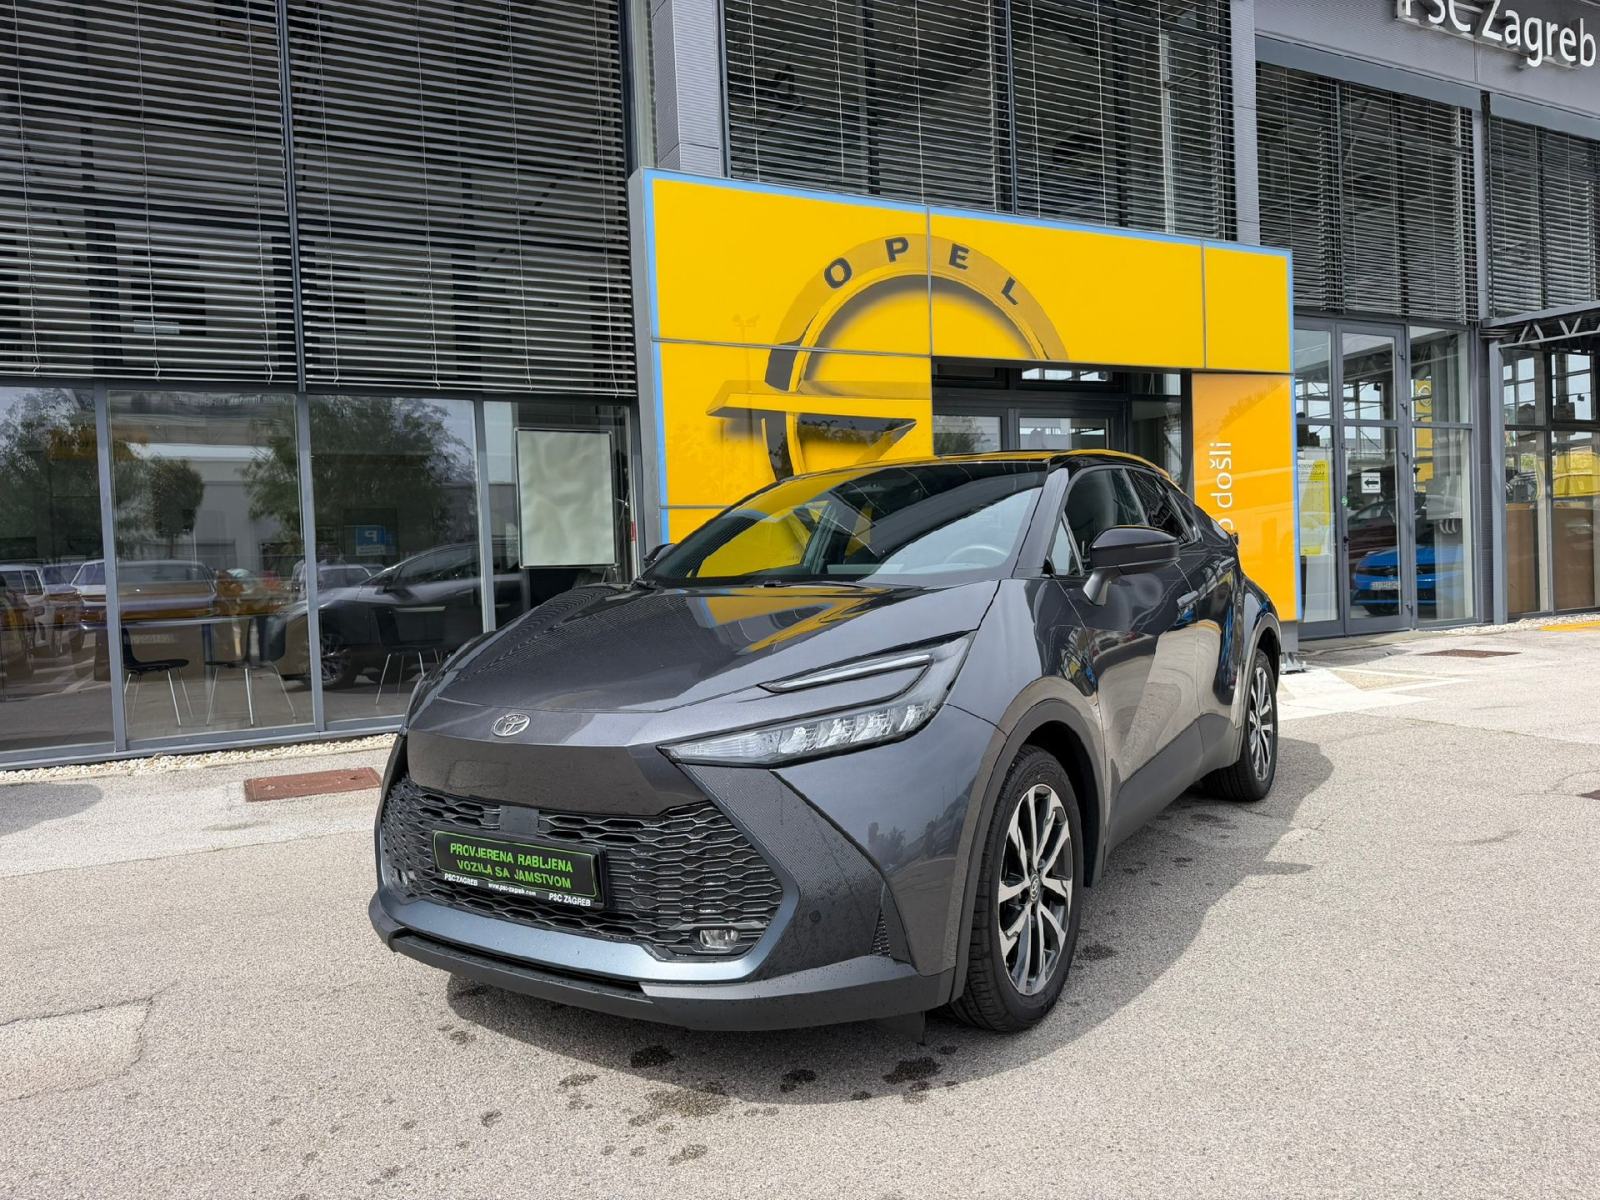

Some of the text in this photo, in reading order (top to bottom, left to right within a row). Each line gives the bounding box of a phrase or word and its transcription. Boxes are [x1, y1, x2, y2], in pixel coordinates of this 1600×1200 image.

[1482, 0, 1597, 67] Zagreb
[823, 236, 1019, 306] OPEL
[1208, 442, 1233, 508] došli
[450, 842, 573, 873] PROVJERENA RABLJENA
[456, 859, 572, 889] VOZILA SA JAMSTVOM
[548, 892, 591, 907] PSC ZAGREB
